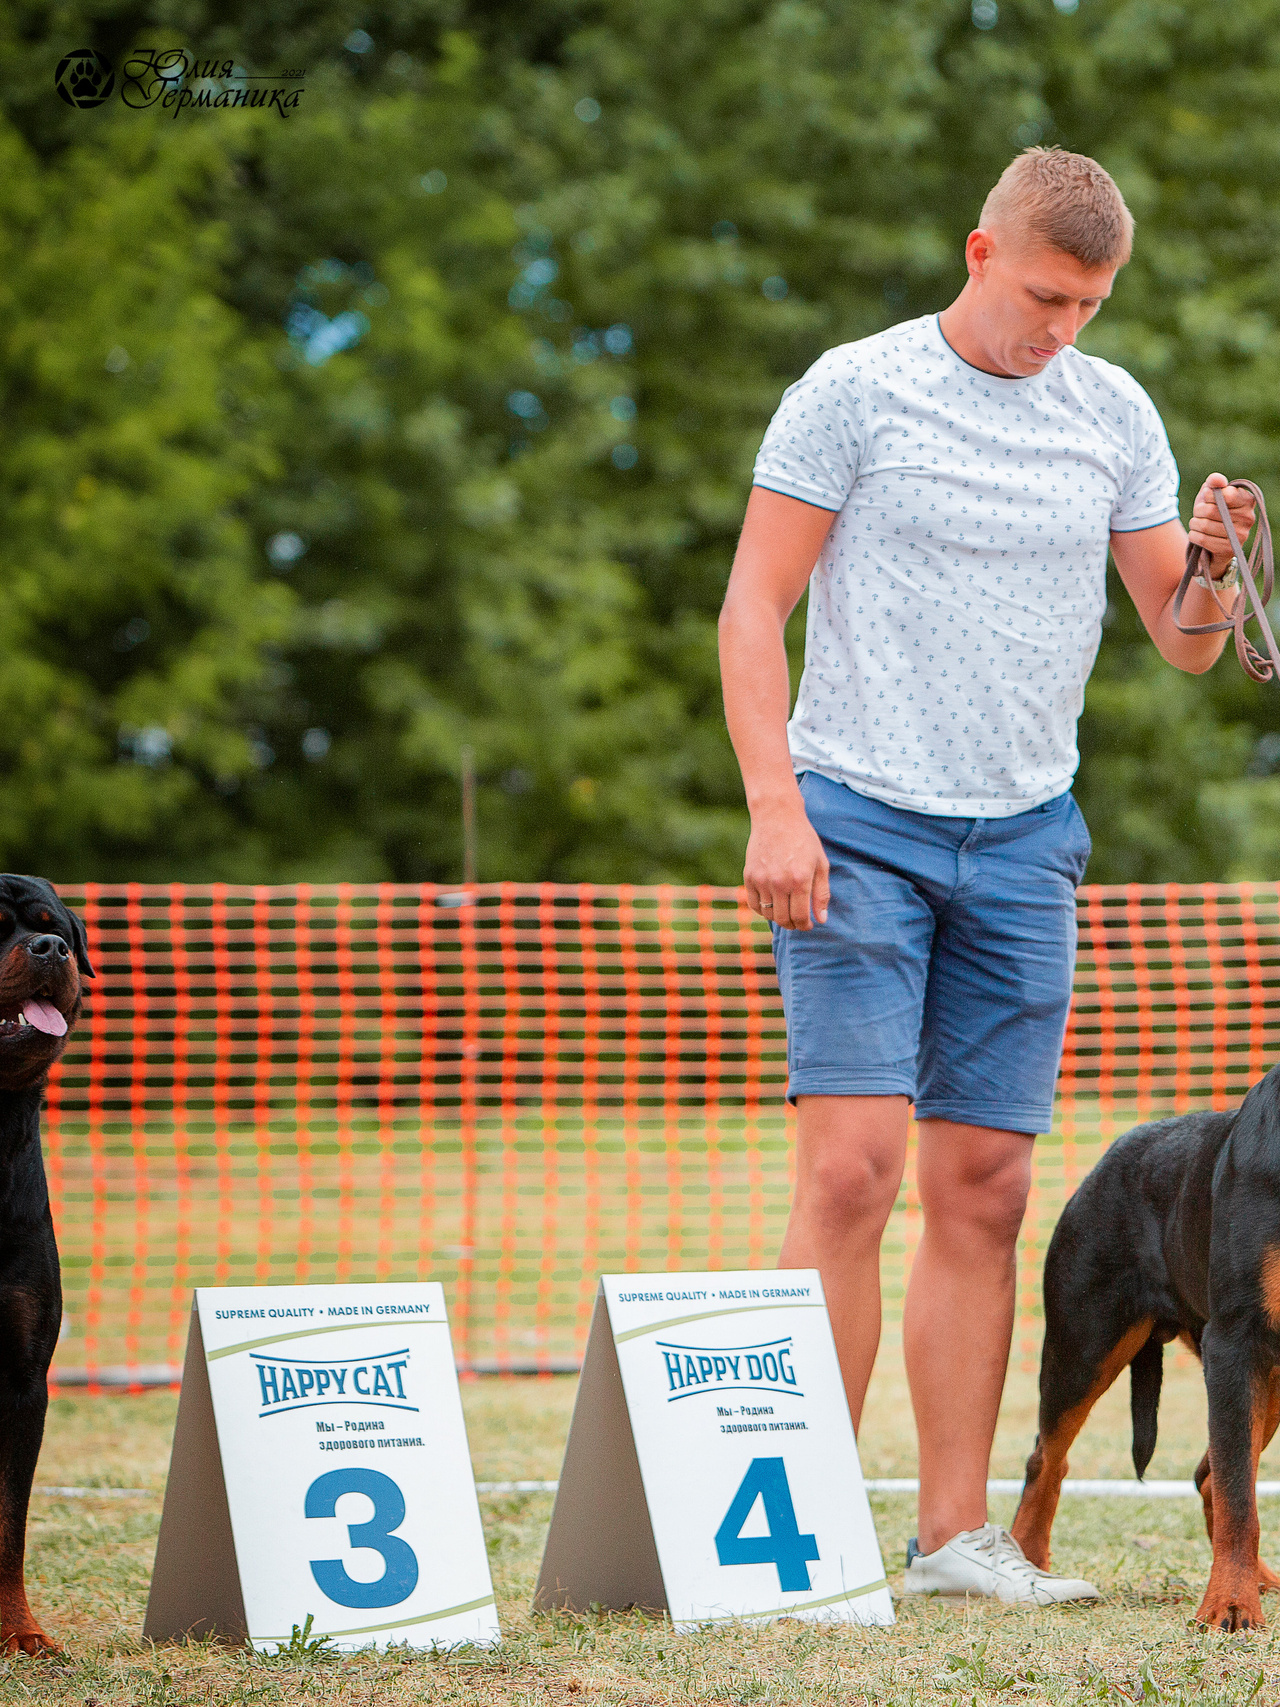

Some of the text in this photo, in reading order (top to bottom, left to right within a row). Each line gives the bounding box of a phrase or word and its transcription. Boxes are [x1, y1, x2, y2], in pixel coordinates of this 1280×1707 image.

[618, 1288, 810, 1302] SUPREME QUALITY MADE IN GERMANY
[215, 1304, 430, 1320] SUPREME QUALITY MADE IN GERMANY
[662, 1348, 797, 1391] HAPPY DOG
[255, 1360, 408, 1406] HAPPY CAT
[716, 1407, 732, 1417] Мы
[741, 1406, 774, 1416] Родина
[316, 1421, 335, 1432] Мы
[345, 1420, 385, 1432] Родина
[720, 1422, 808, 1435] здорового питания.
[319, 1437, 425, 1451] здорового питания.
[714, 1457, 820, 1592] 4
[304, 1467, 419, 1609] 3
